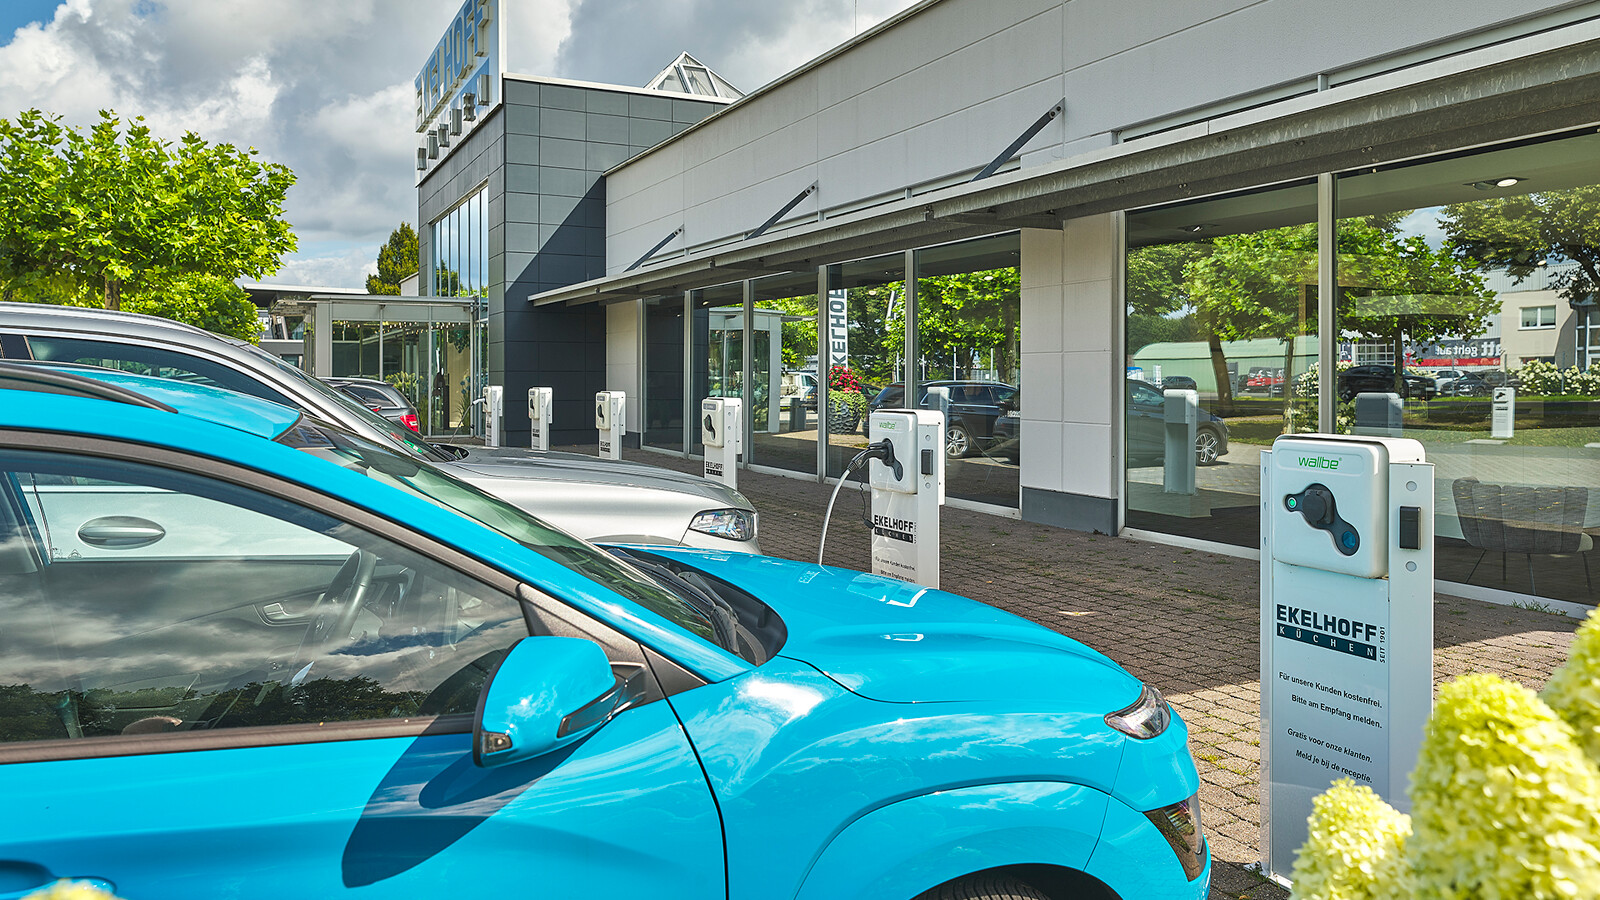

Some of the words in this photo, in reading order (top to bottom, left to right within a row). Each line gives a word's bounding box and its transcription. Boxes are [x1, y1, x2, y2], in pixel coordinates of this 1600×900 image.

[874, 515, 914, 533] EKELHOFF
[1277, 604, 1377, 641] EKELHOFF
[1279, 626, 1374, 657] KÜCHEN
[1279, 671, 1290, 681] Für
[1291, 676, 1314, 688] unsere
[1315, 682, 1342, 697] Kunden
[1343, 690, 1382, 709] kostenfrei.
[1291, 694, 1307, 706] Bitte
[1308, 700, 1319, 709] am
[1320, 703, 1351, 721] Empfang
[1352, 714, 1383, 729] melden.
[1287, 728, 1307, 740] Gratis
[1308, 736, 1324, 746] voor
[1325, 742, 1342, 753] onze
[1343, 747, 1373, 763] klanten.
[1295, 749, 1312, 761] Meld
[1312, 755, 1320, 764] je
[1321, 758, 1330, 769] bij
[1331, 763, 1340, 772] de
[1341, 767, 1373, 784] receptie.
